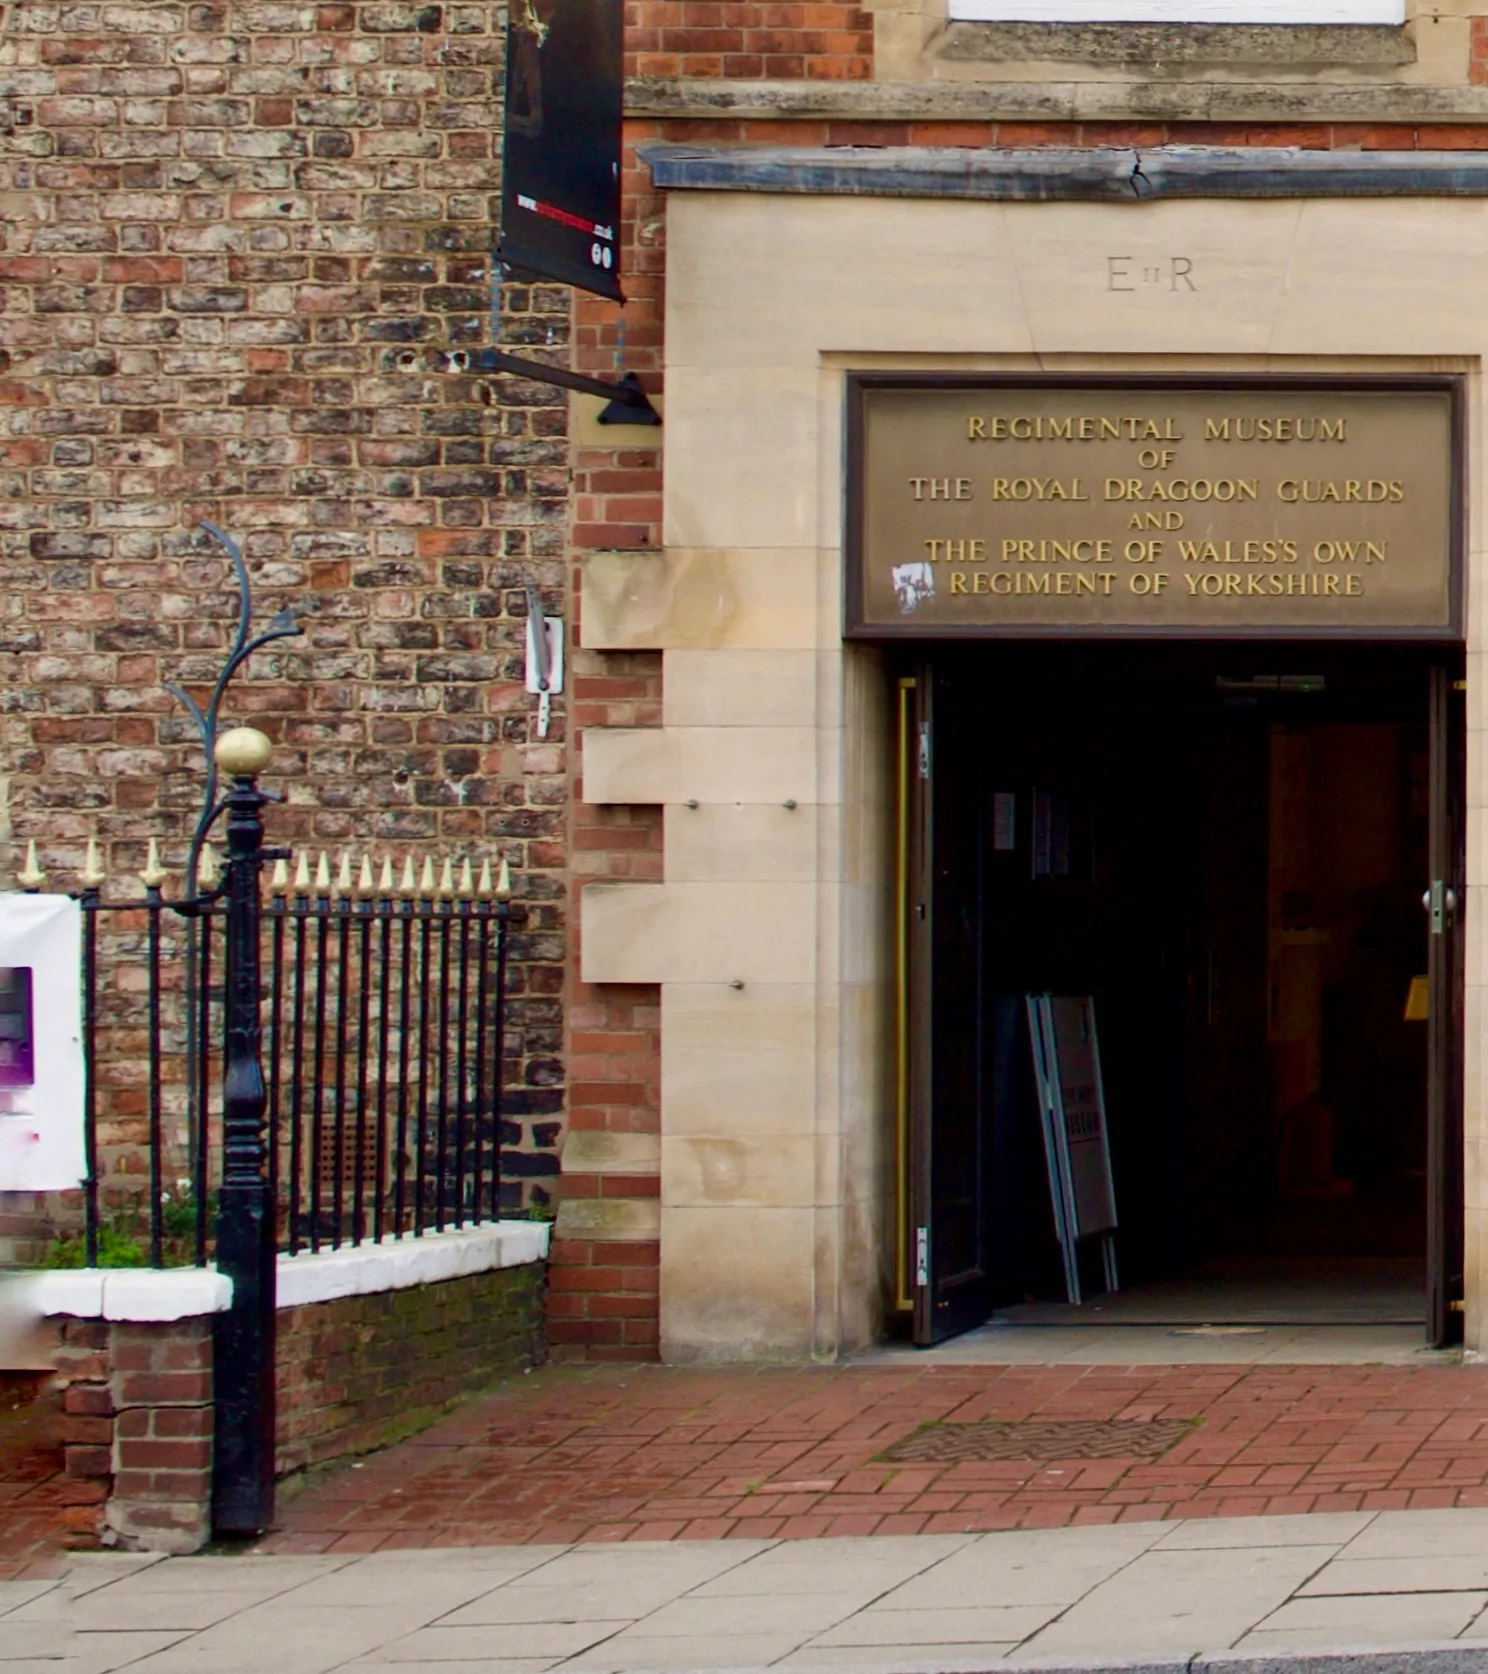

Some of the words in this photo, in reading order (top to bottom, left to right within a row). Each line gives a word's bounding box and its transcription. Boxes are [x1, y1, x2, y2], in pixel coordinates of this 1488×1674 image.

[968, 417, 1183, 441] REGIMENTAL
[1204, 418, 1346, 442] MUSEUM
[1138, 450, 1175, 469] OF
[909, 477, 972, 501] THE
[992, 478, 1088, 501] ROYAL
[1104, 478, 1259, 502] DRAGOON
[1276, 479, 1404, 503] GUARDS
[1127, 511, 1184, 530] AND
[925, 539, 986, 562] THE
[1001, 539, 1113, 562] PRINCE
[1124, 540, 1164, 562] OF
[1178, 539, 1298, 563] WALES'S
[1313, 541, 1388, 563] OWN
[948, 571, 1116, 594] REGIMENT
[1129, 572, 1170, 594] OF
[1183, 572, 1364, 596] YORKSHIRE
